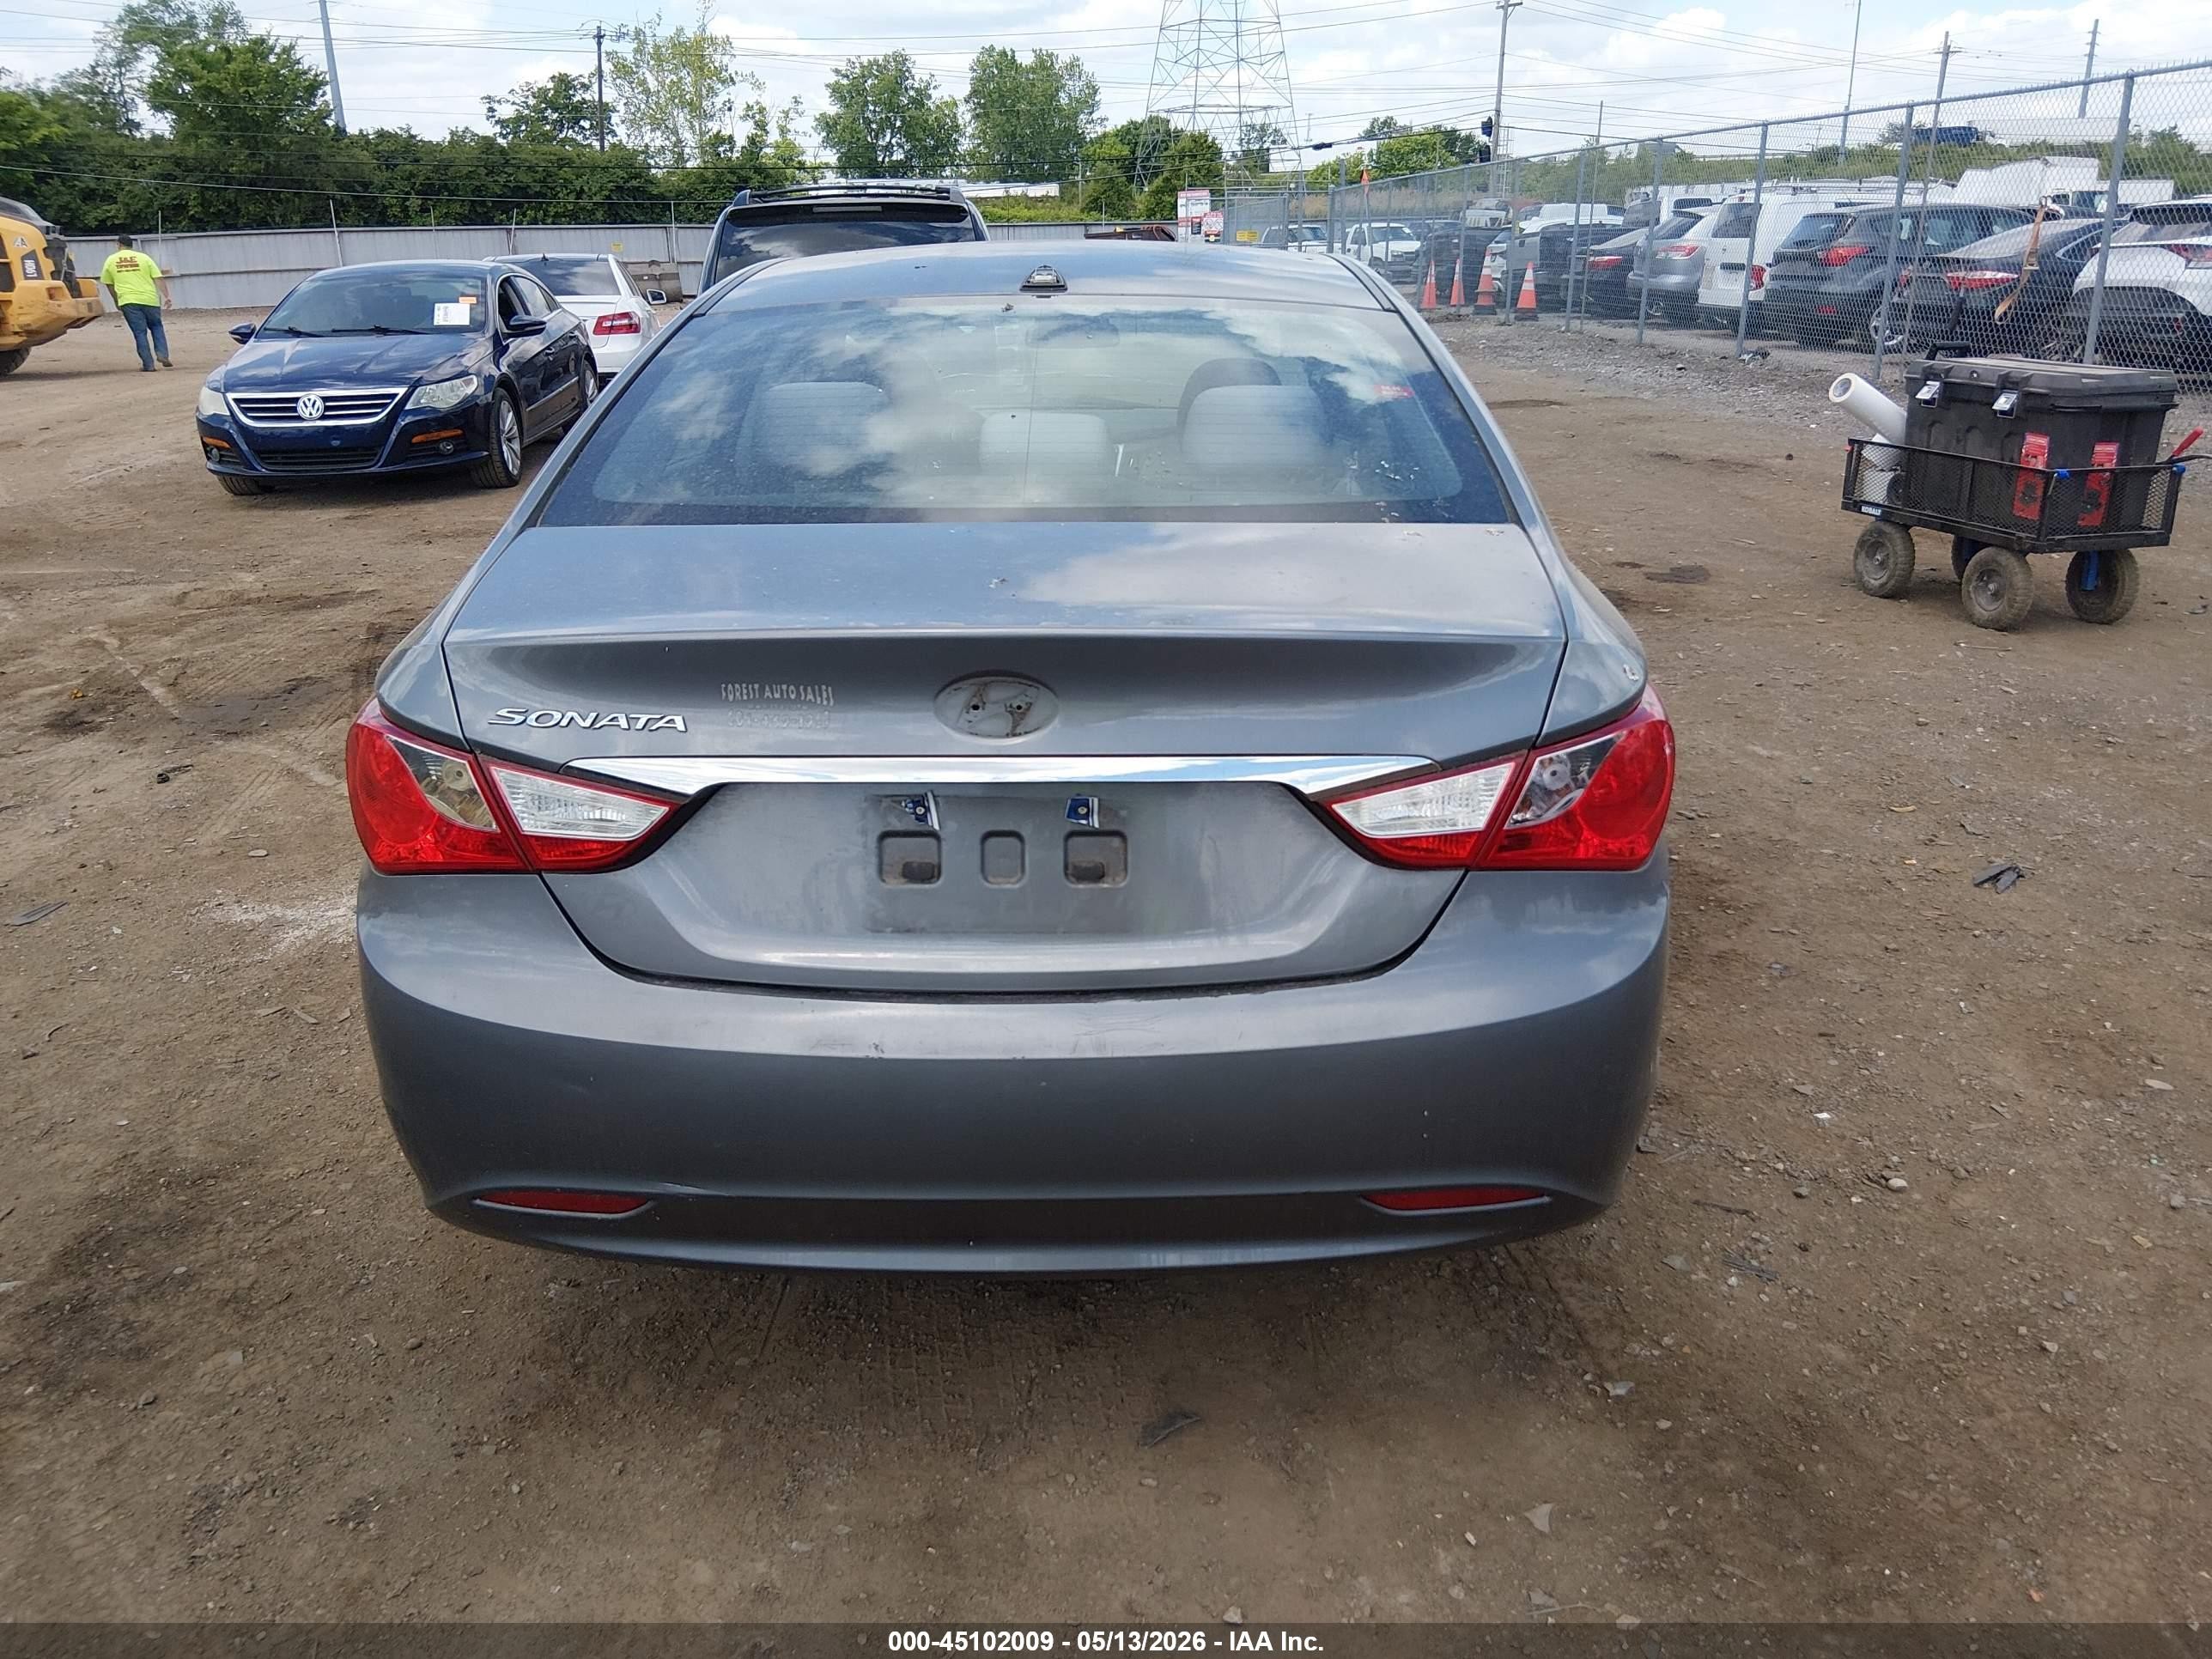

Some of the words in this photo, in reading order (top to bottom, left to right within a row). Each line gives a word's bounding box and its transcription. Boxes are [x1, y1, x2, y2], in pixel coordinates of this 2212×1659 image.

[23, 259, 38, 277] L90H
[720, 683, 759, 702] FOREST
[763, 684, 797, 700] AUTO
[799, 684, 835, 707] SALES
[487, 707, 688, 732] SONATA
